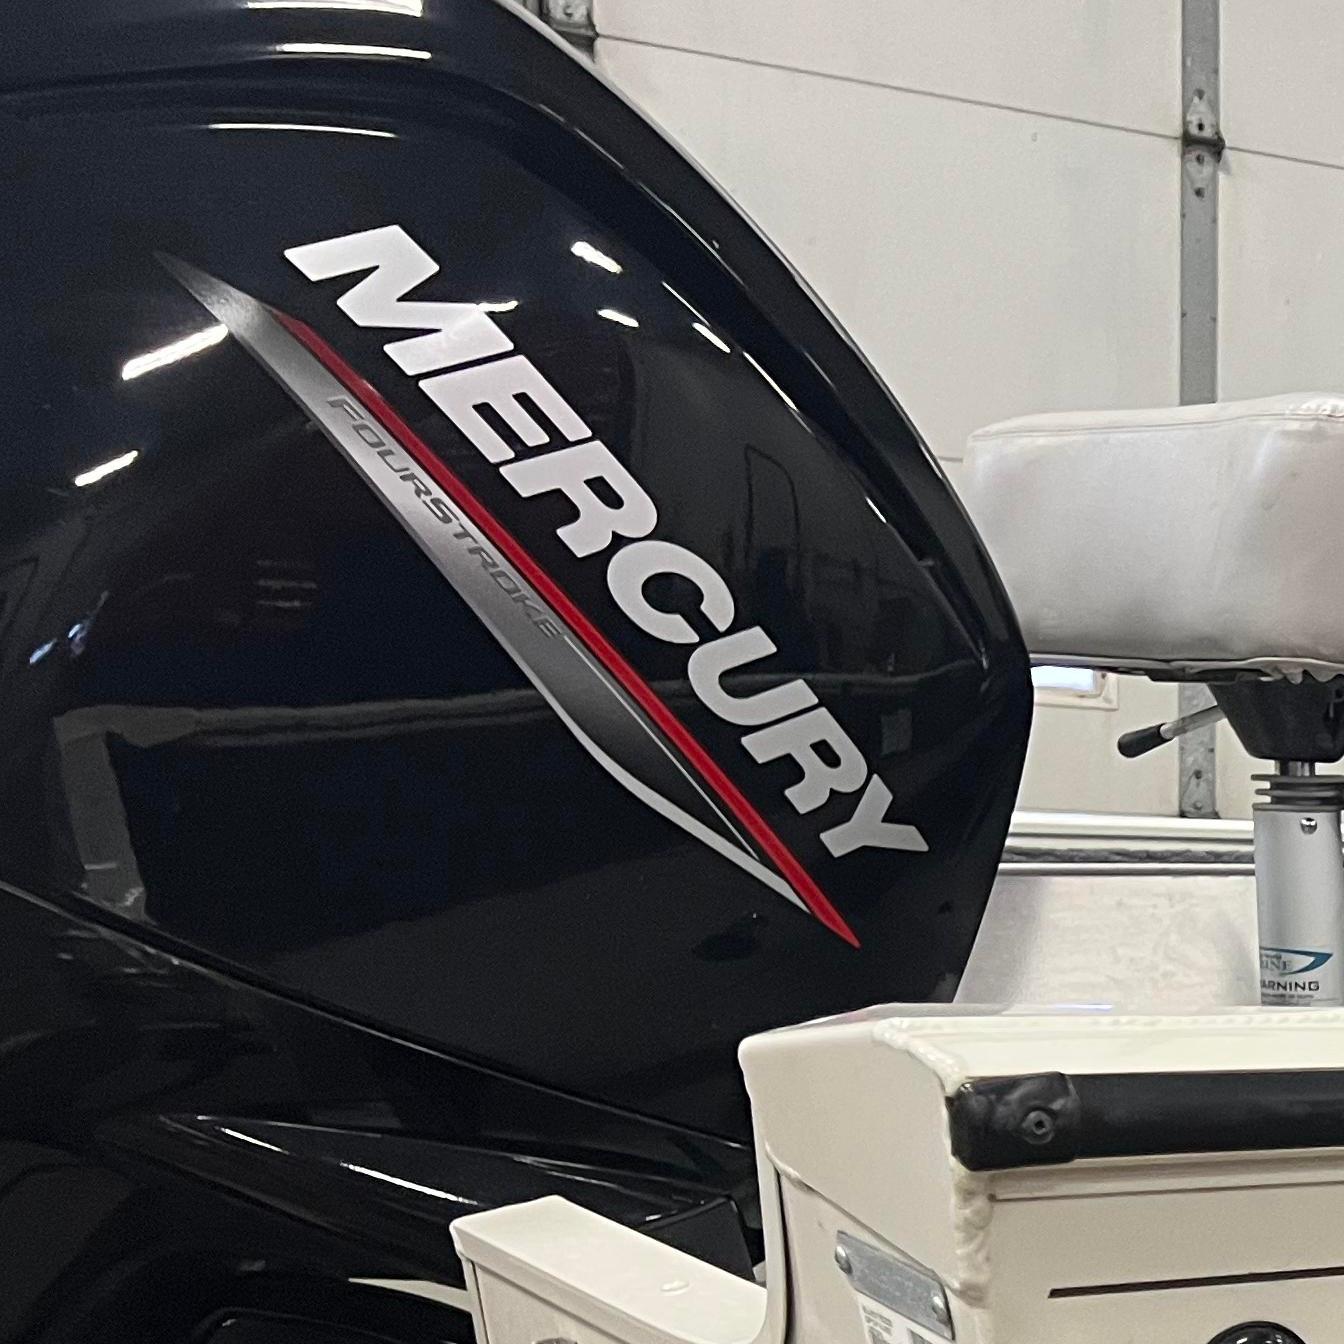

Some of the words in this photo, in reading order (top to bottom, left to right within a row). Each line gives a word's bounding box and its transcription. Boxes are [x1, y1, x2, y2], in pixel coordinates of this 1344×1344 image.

[283, 224, 929, 858] MERCURY
[327, 395, 562, 638] FOURSTROKE
[1261, 980, 1320, 992] ARNING
